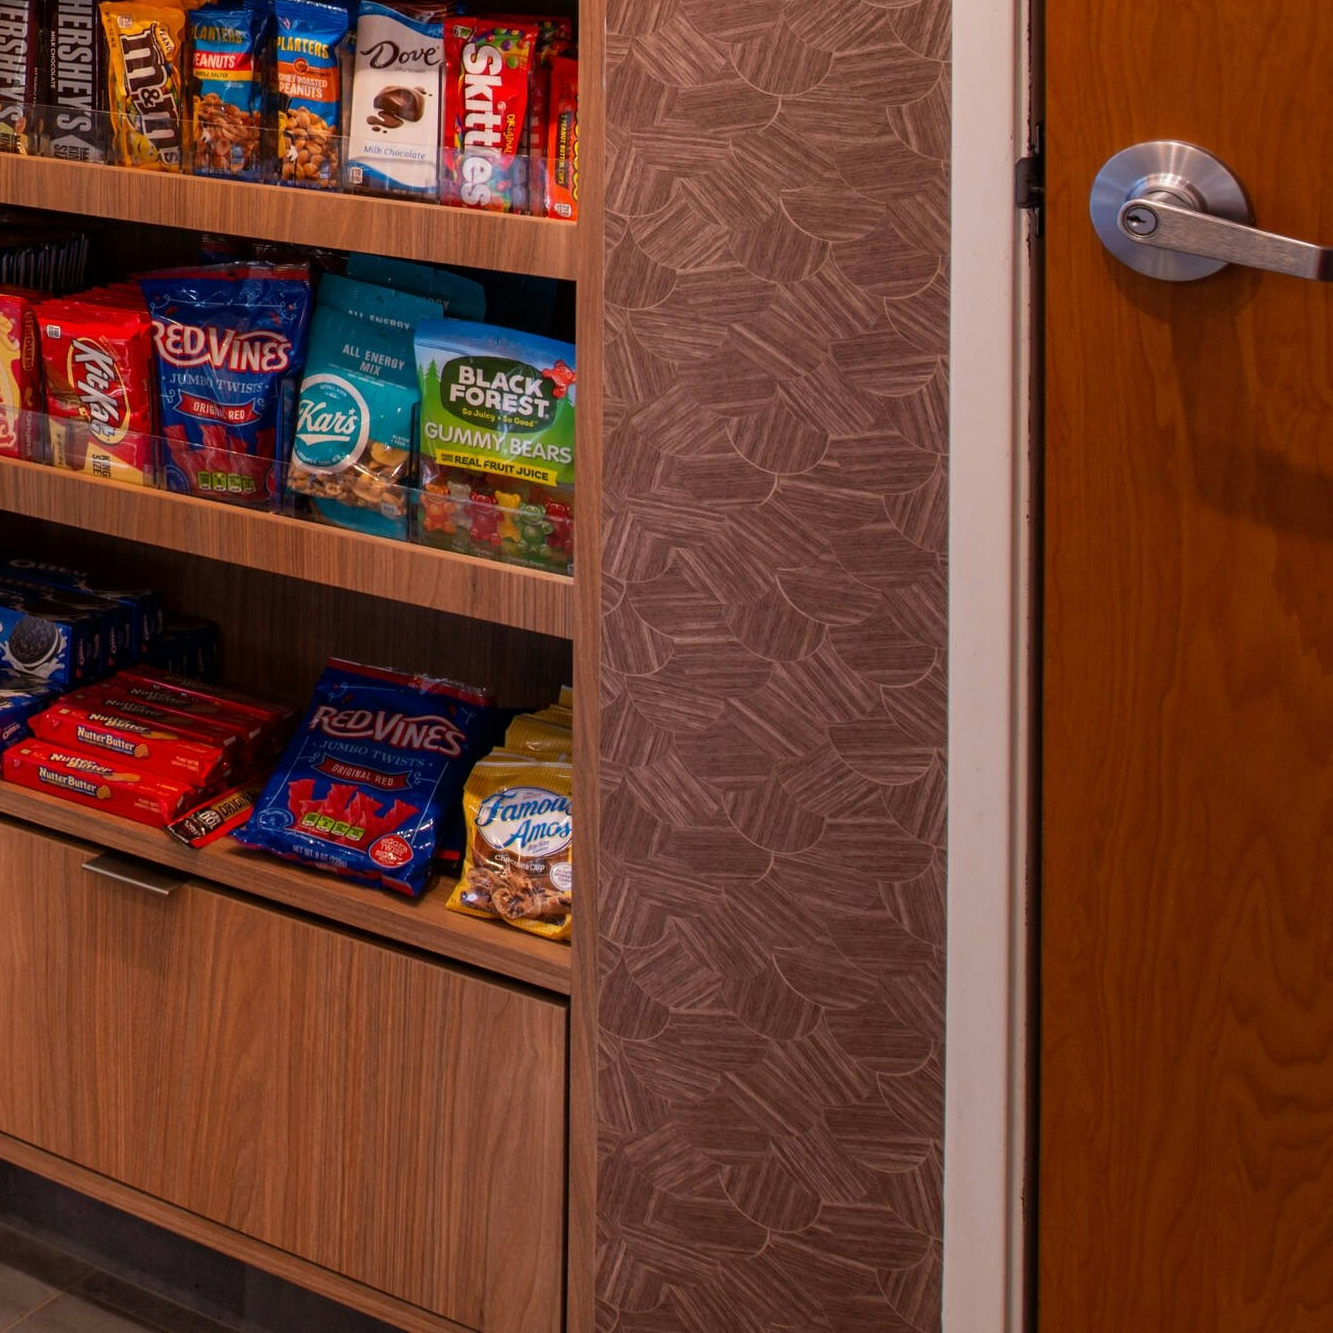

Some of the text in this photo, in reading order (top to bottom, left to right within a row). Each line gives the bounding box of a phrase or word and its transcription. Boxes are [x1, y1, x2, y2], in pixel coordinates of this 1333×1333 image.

[276, 37, 329, 58] PLANTERS
[279, 83, 323, 99] PEANUTS
[461, 44, 502, 206] Skittles
[363, 144, 426, 160] Milk Chocolate
[342, 343, 405, 371] ALL ENERGY
[359, 361, 382, 376] MIX
[458, 365, 543, 399] BLACK
[450, 383, 549, 419] FOREST
[297, 399, 357, 435] Kar's
[473, 408, 495, 422] Juicy
[514, 416, 534, 427] Good
[424, 422, 572, 464] GUMMY BEARS
[91, 453, 101, 475] SIZE
[100, 454, 111, 478] KING
[454, 455, 549, 481] REAL FRUIT JUICE
[312, 706, 466, 756] RED VINES
[319, 740, 424, 767] JUMBO TWISTS
[493, 817, 571, 849] Amos
